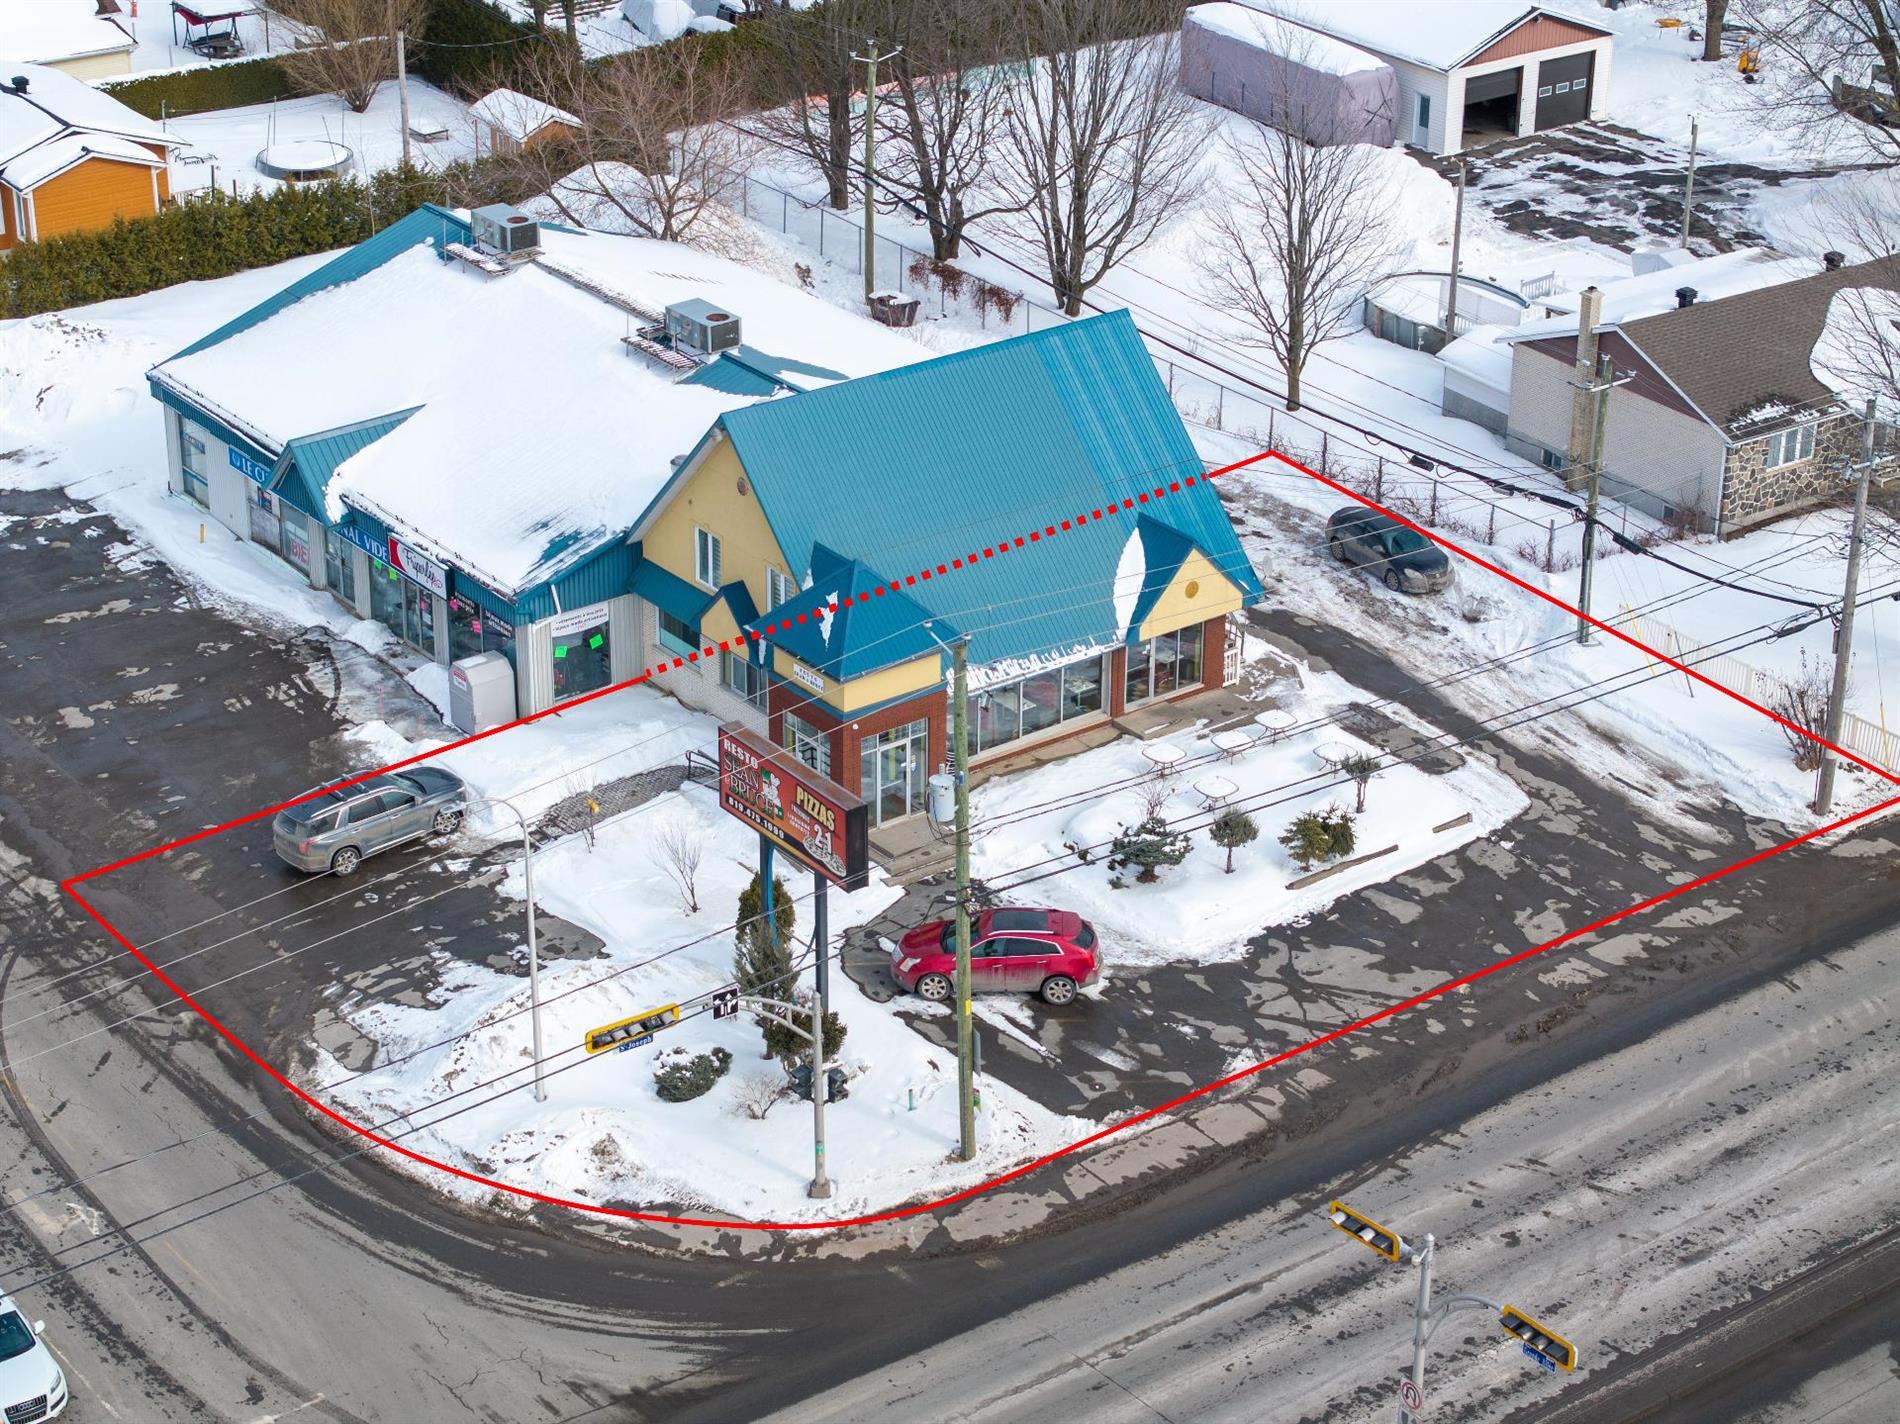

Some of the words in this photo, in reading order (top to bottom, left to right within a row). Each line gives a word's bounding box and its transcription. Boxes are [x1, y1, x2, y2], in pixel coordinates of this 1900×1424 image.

[242, 458, 253, 476] LE
[724, 738, 759, 770] RESTO
[724, 752, 759, 790] SEAN
[729, 774, 774, 816] BRUCE
[796, 785, 835, 832] PIZZAS
[628, 1036, 652, 1049] Joseph
